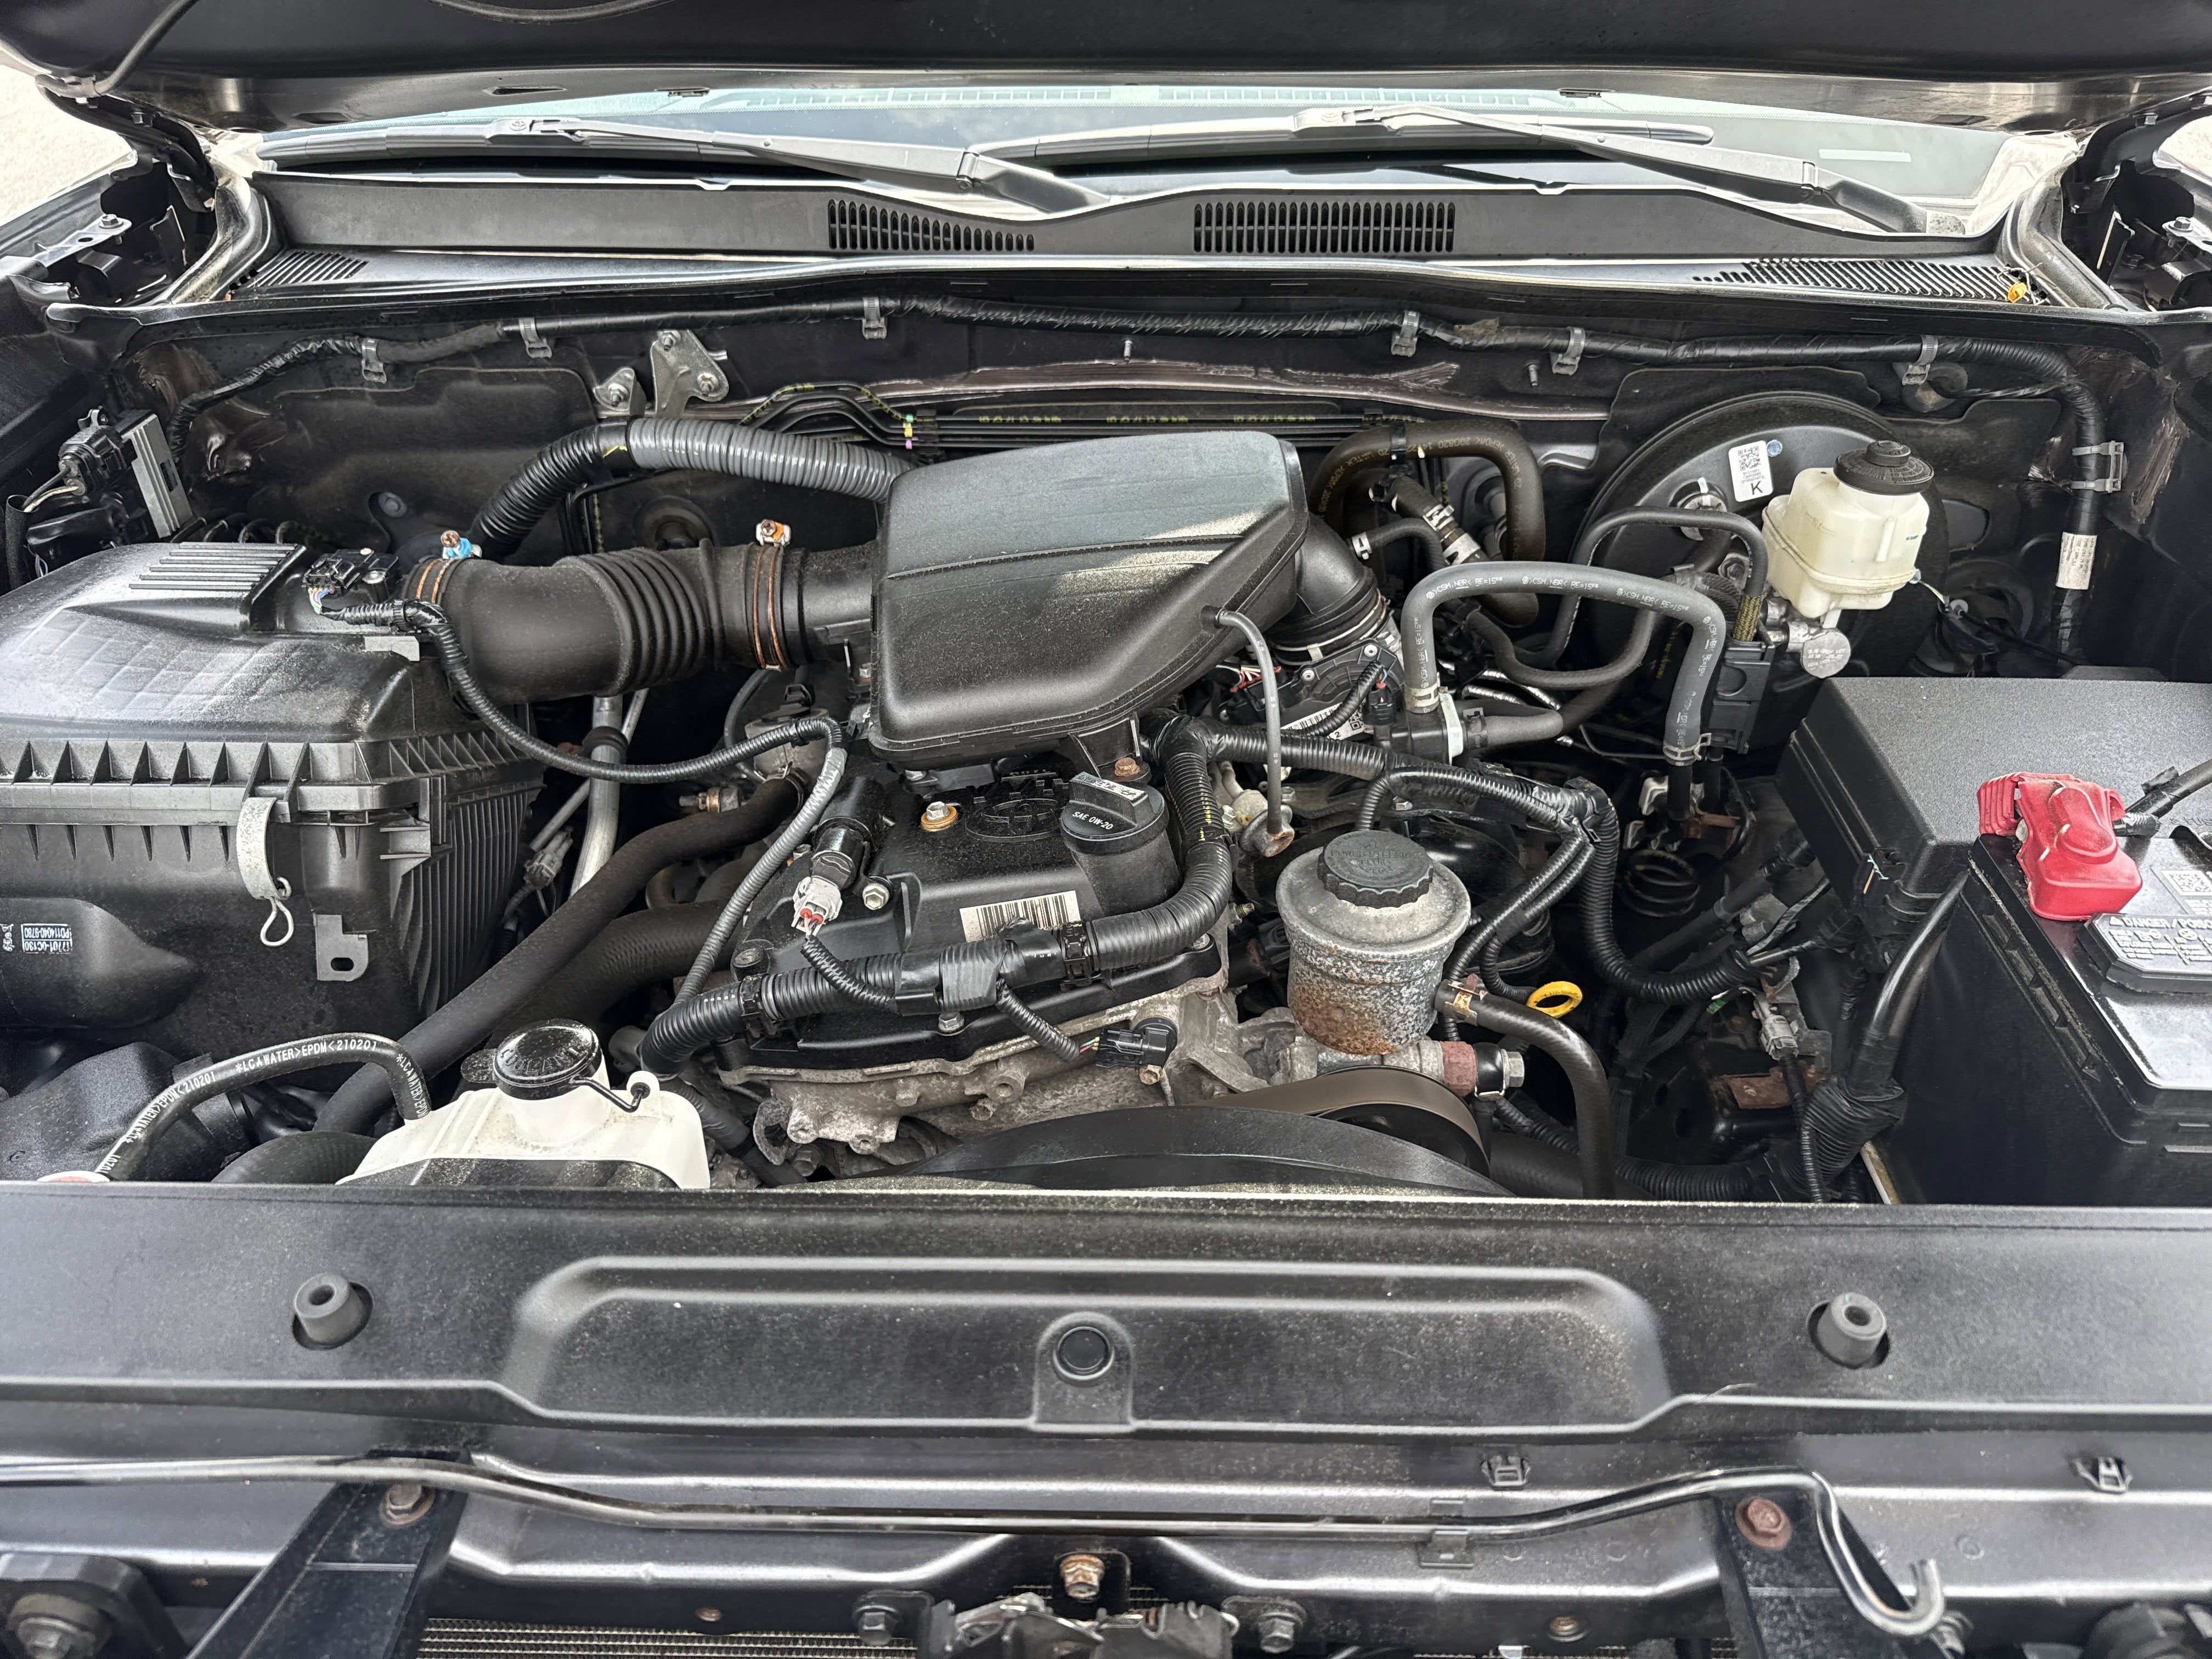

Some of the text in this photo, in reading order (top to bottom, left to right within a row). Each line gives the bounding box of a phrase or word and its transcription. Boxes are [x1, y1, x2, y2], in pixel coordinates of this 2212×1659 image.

[1751, 481, 1763, 495] K
[1072, 811, 1114, 830] SAE 0W-20
[2121, 917, 2171, 929] DANGER
